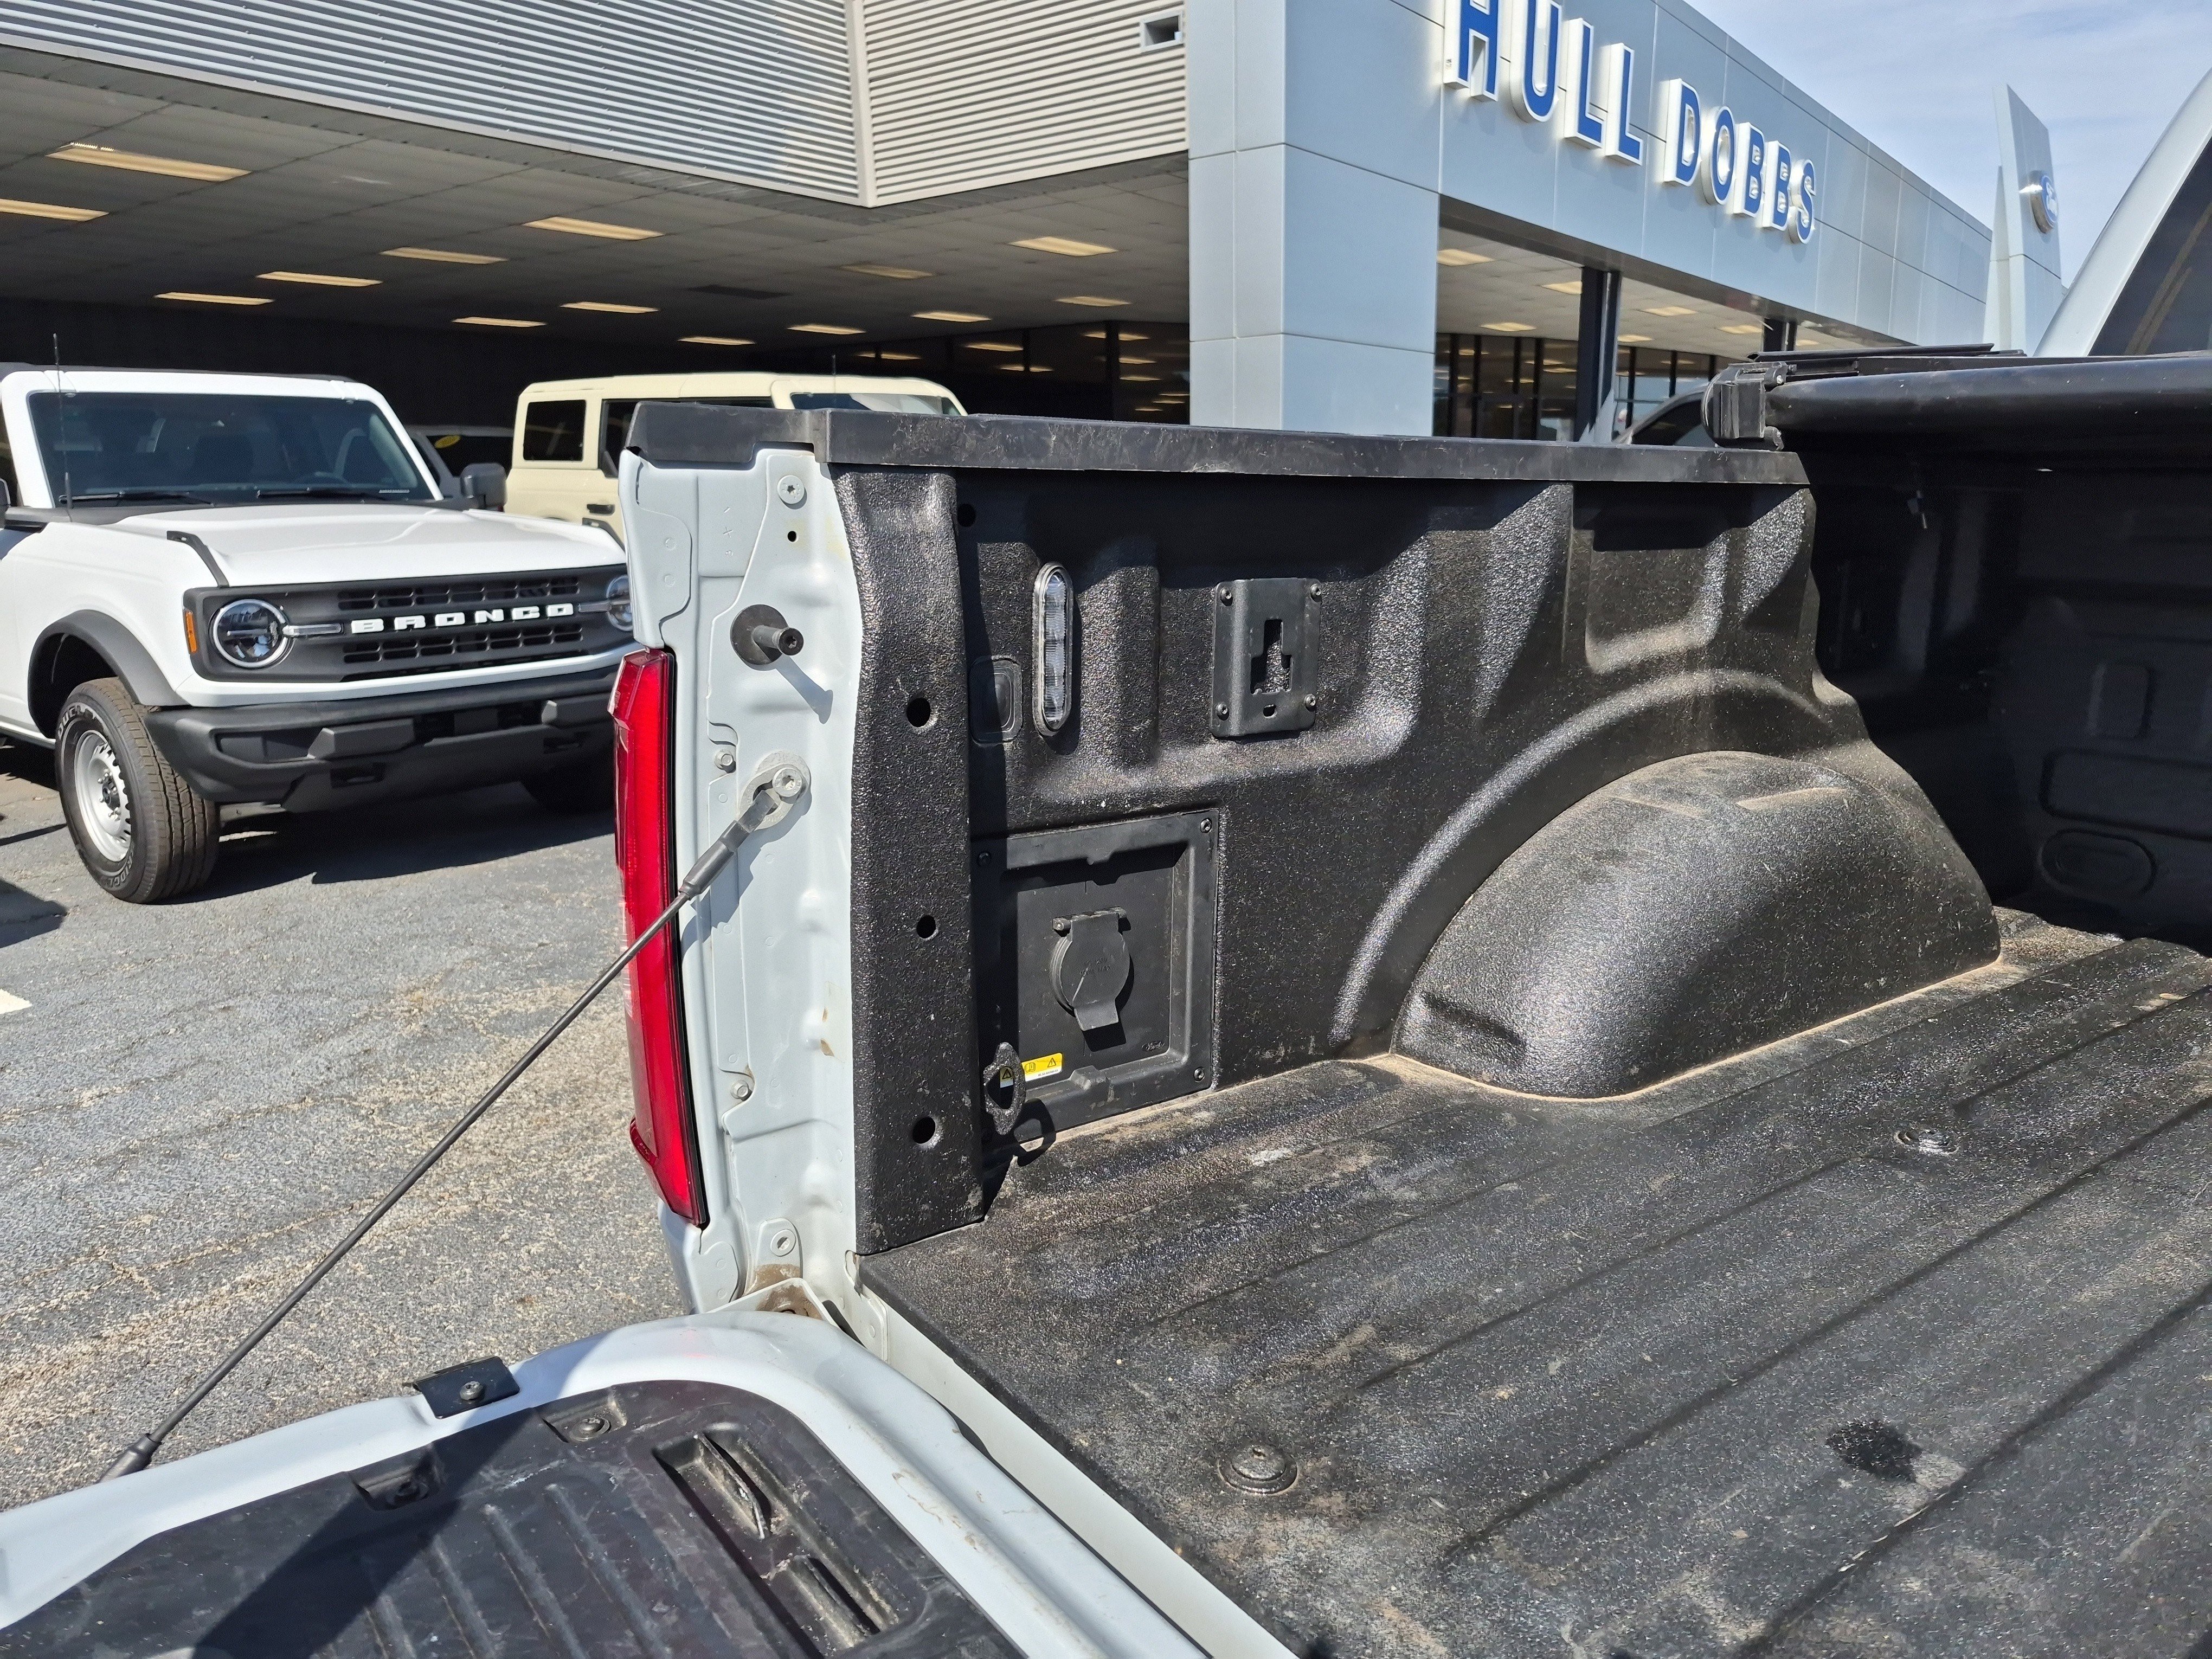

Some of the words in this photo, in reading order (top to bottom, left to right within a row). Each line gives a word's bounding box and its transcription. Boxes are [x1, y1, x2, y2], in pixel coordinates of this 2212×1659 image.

[1444, 0, 1643, 166] HULL
[1663, 78, 1816, 244] DOBBS
[351, 602, 574, 634] BRONCO
